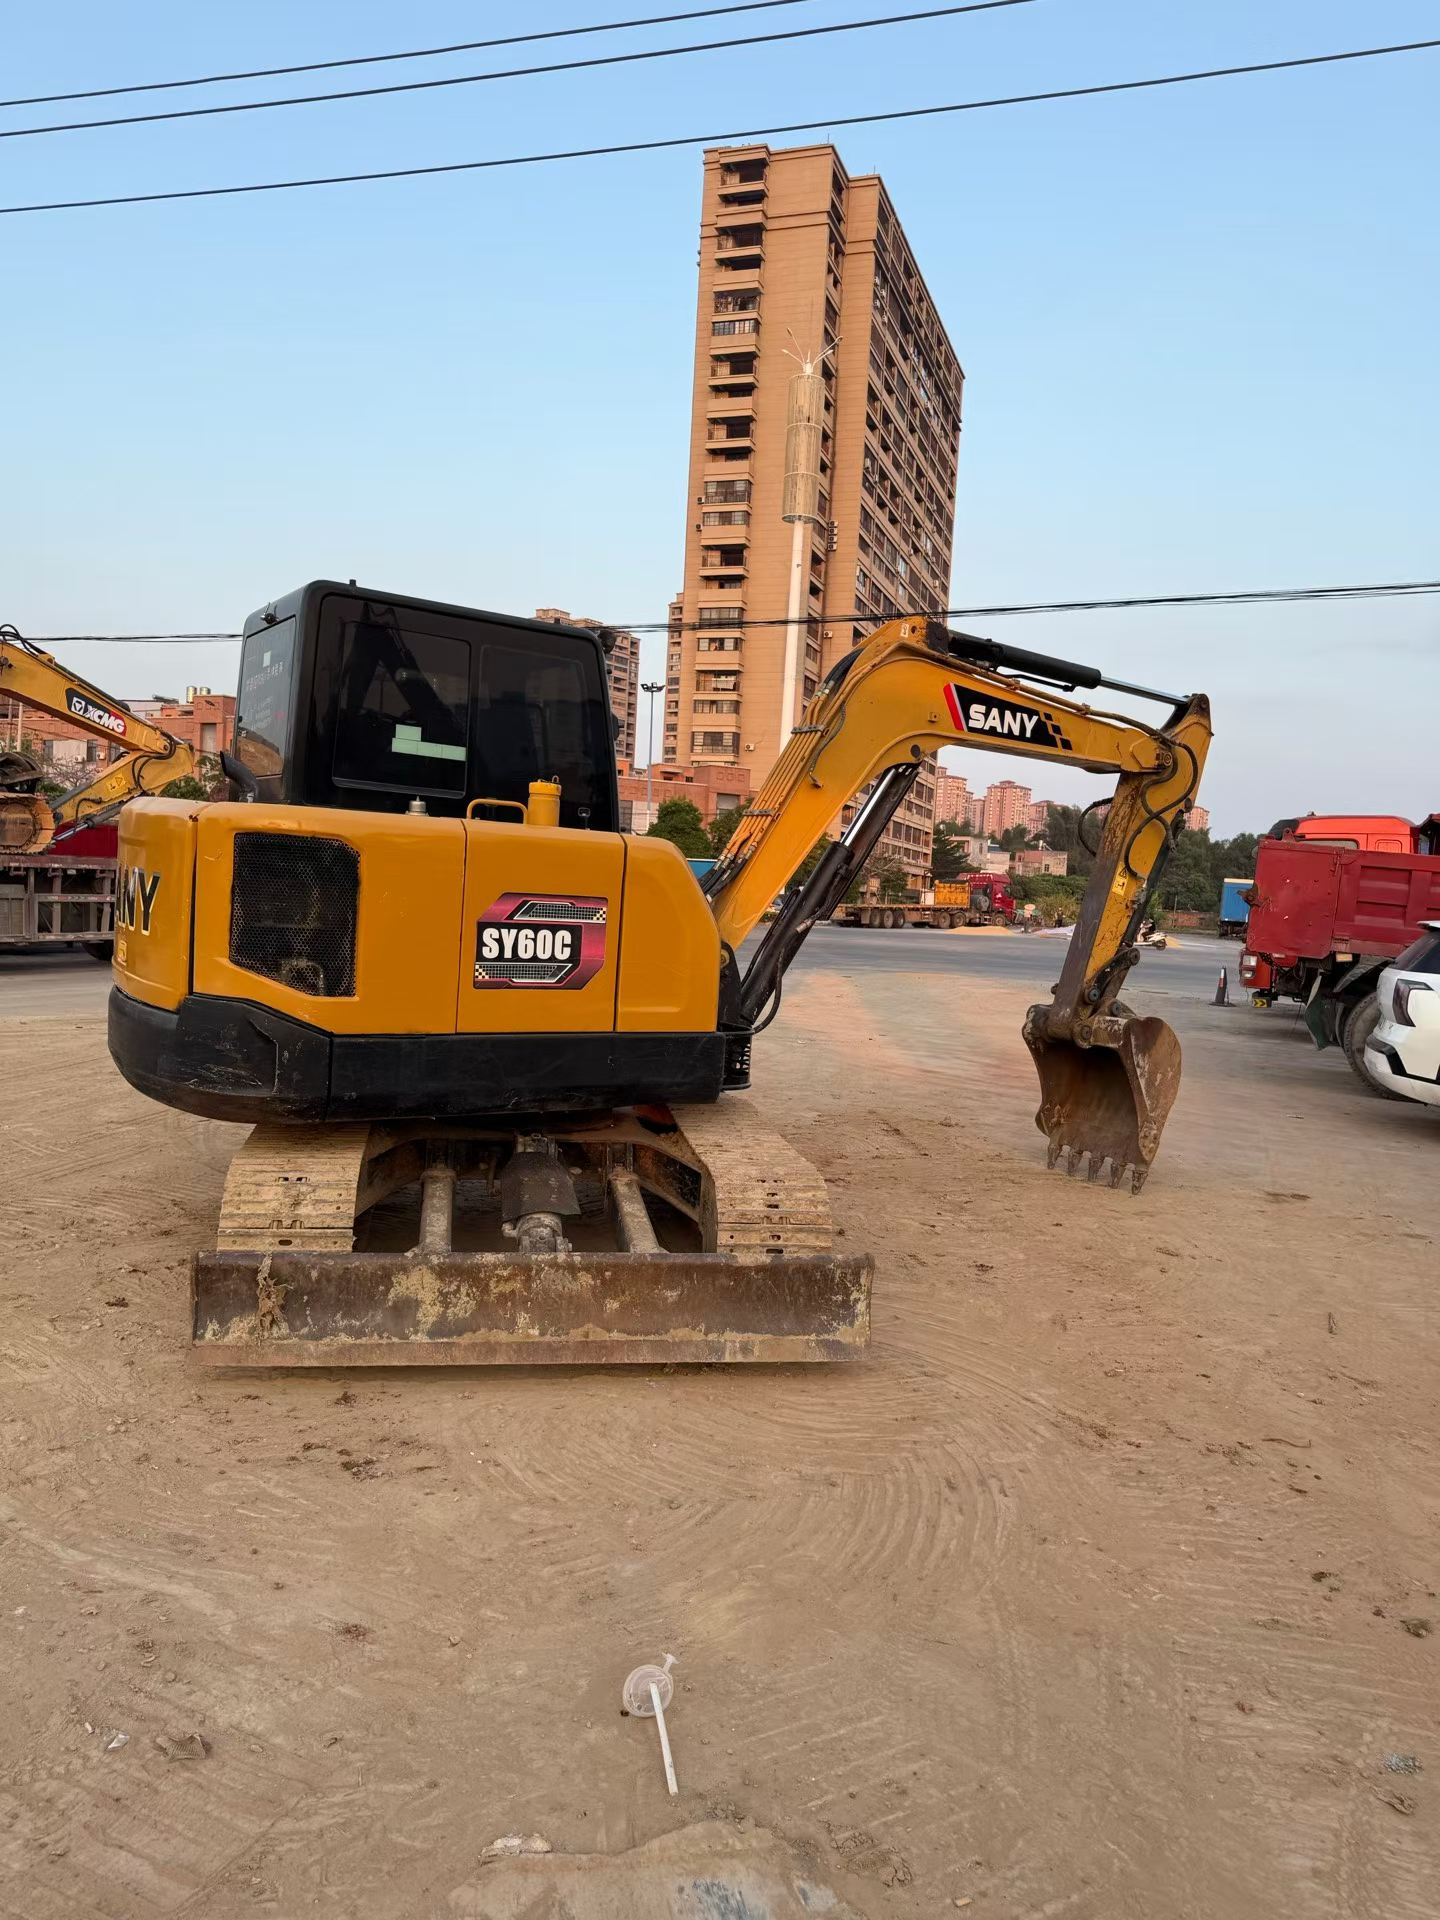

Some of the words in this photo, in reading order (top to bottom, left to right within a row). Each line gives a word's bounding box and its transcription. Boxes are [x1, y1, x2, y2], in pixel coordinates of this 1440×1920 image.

[83, 704, 125, 733] XCMG
[968, 703, 1039, 738] SANY
[482, 927, 572, 960] SY60C
